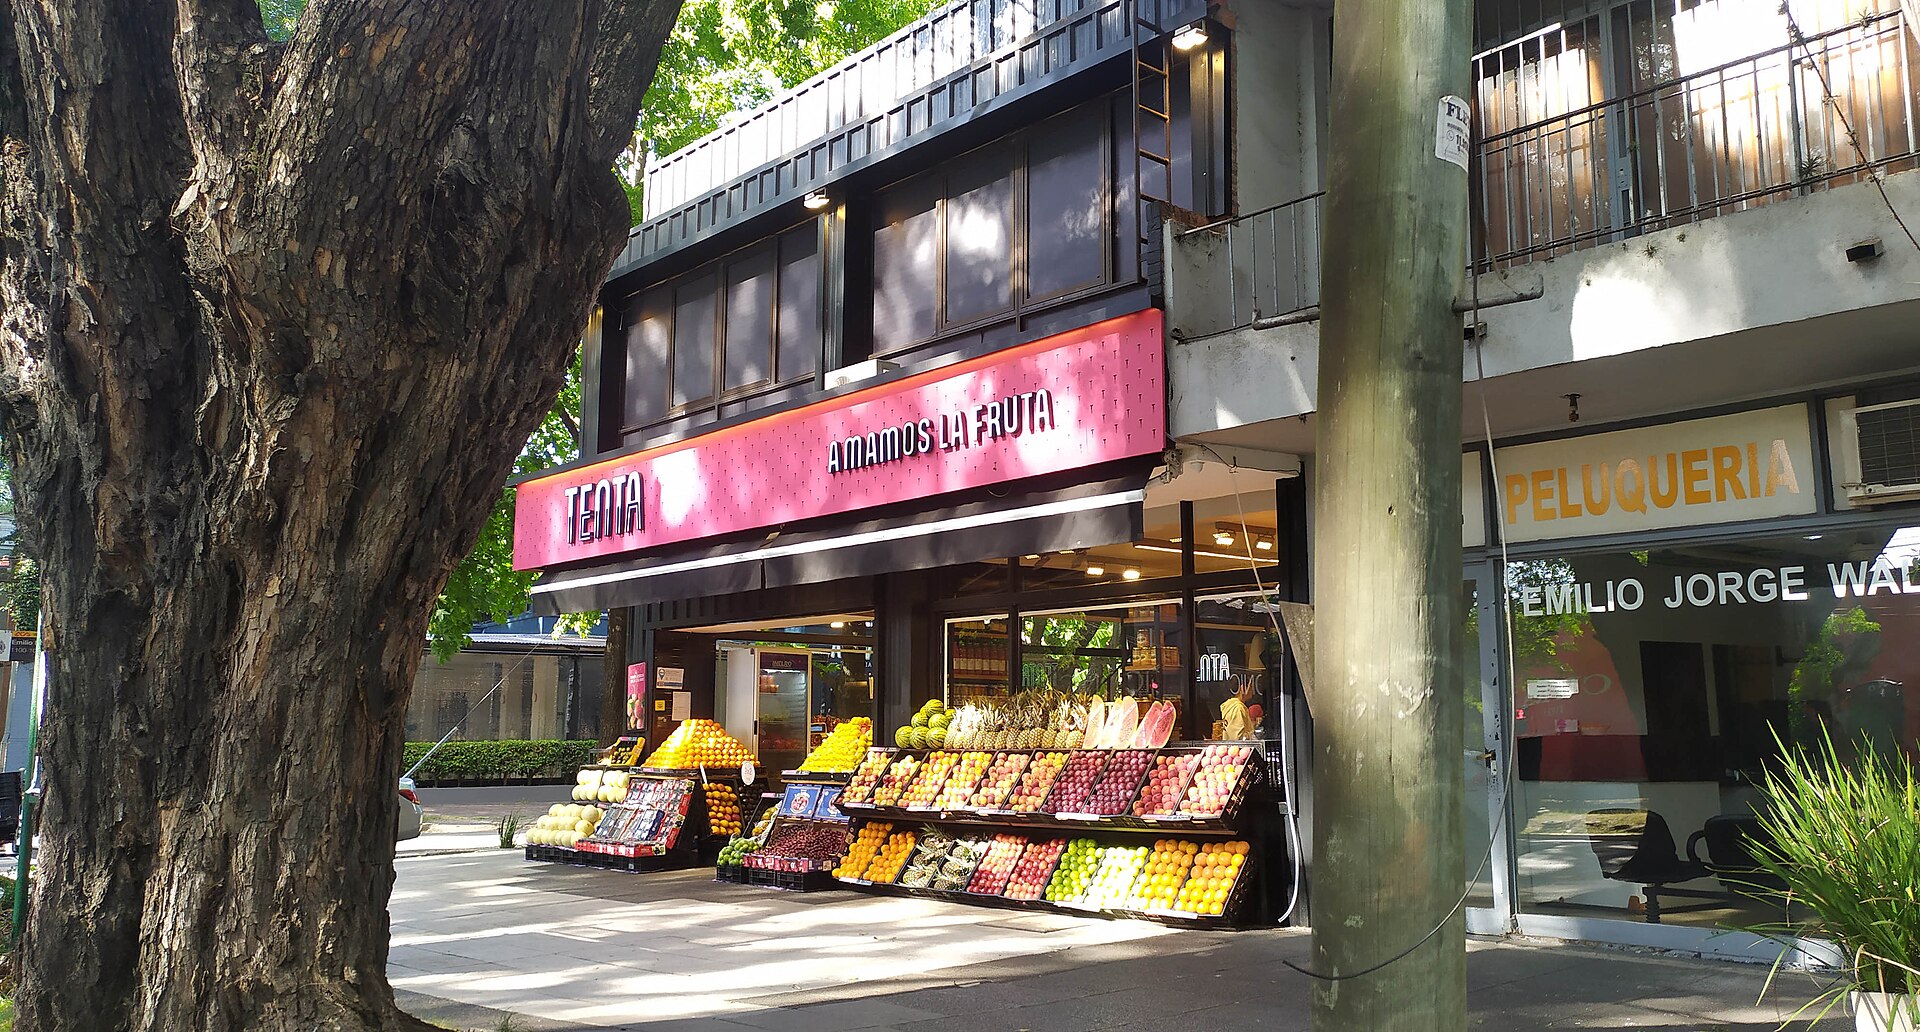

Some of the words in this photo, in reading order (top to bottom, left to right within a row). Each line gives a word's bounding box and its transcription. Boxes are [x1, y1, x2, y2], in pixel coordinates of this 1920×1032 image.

[827, 417, 934, 474] AMAMOS
[938, 410, 968, 452] LA
[973, 388, 1055, 446] FRUTA
[564, 470, 645, 544] TENTA
[1505, 438, 1801, 525] PELUQUERIA
[1523, 577, 1645, 617] EMILIO
[1663, 566, 1810, 610] JORGE
